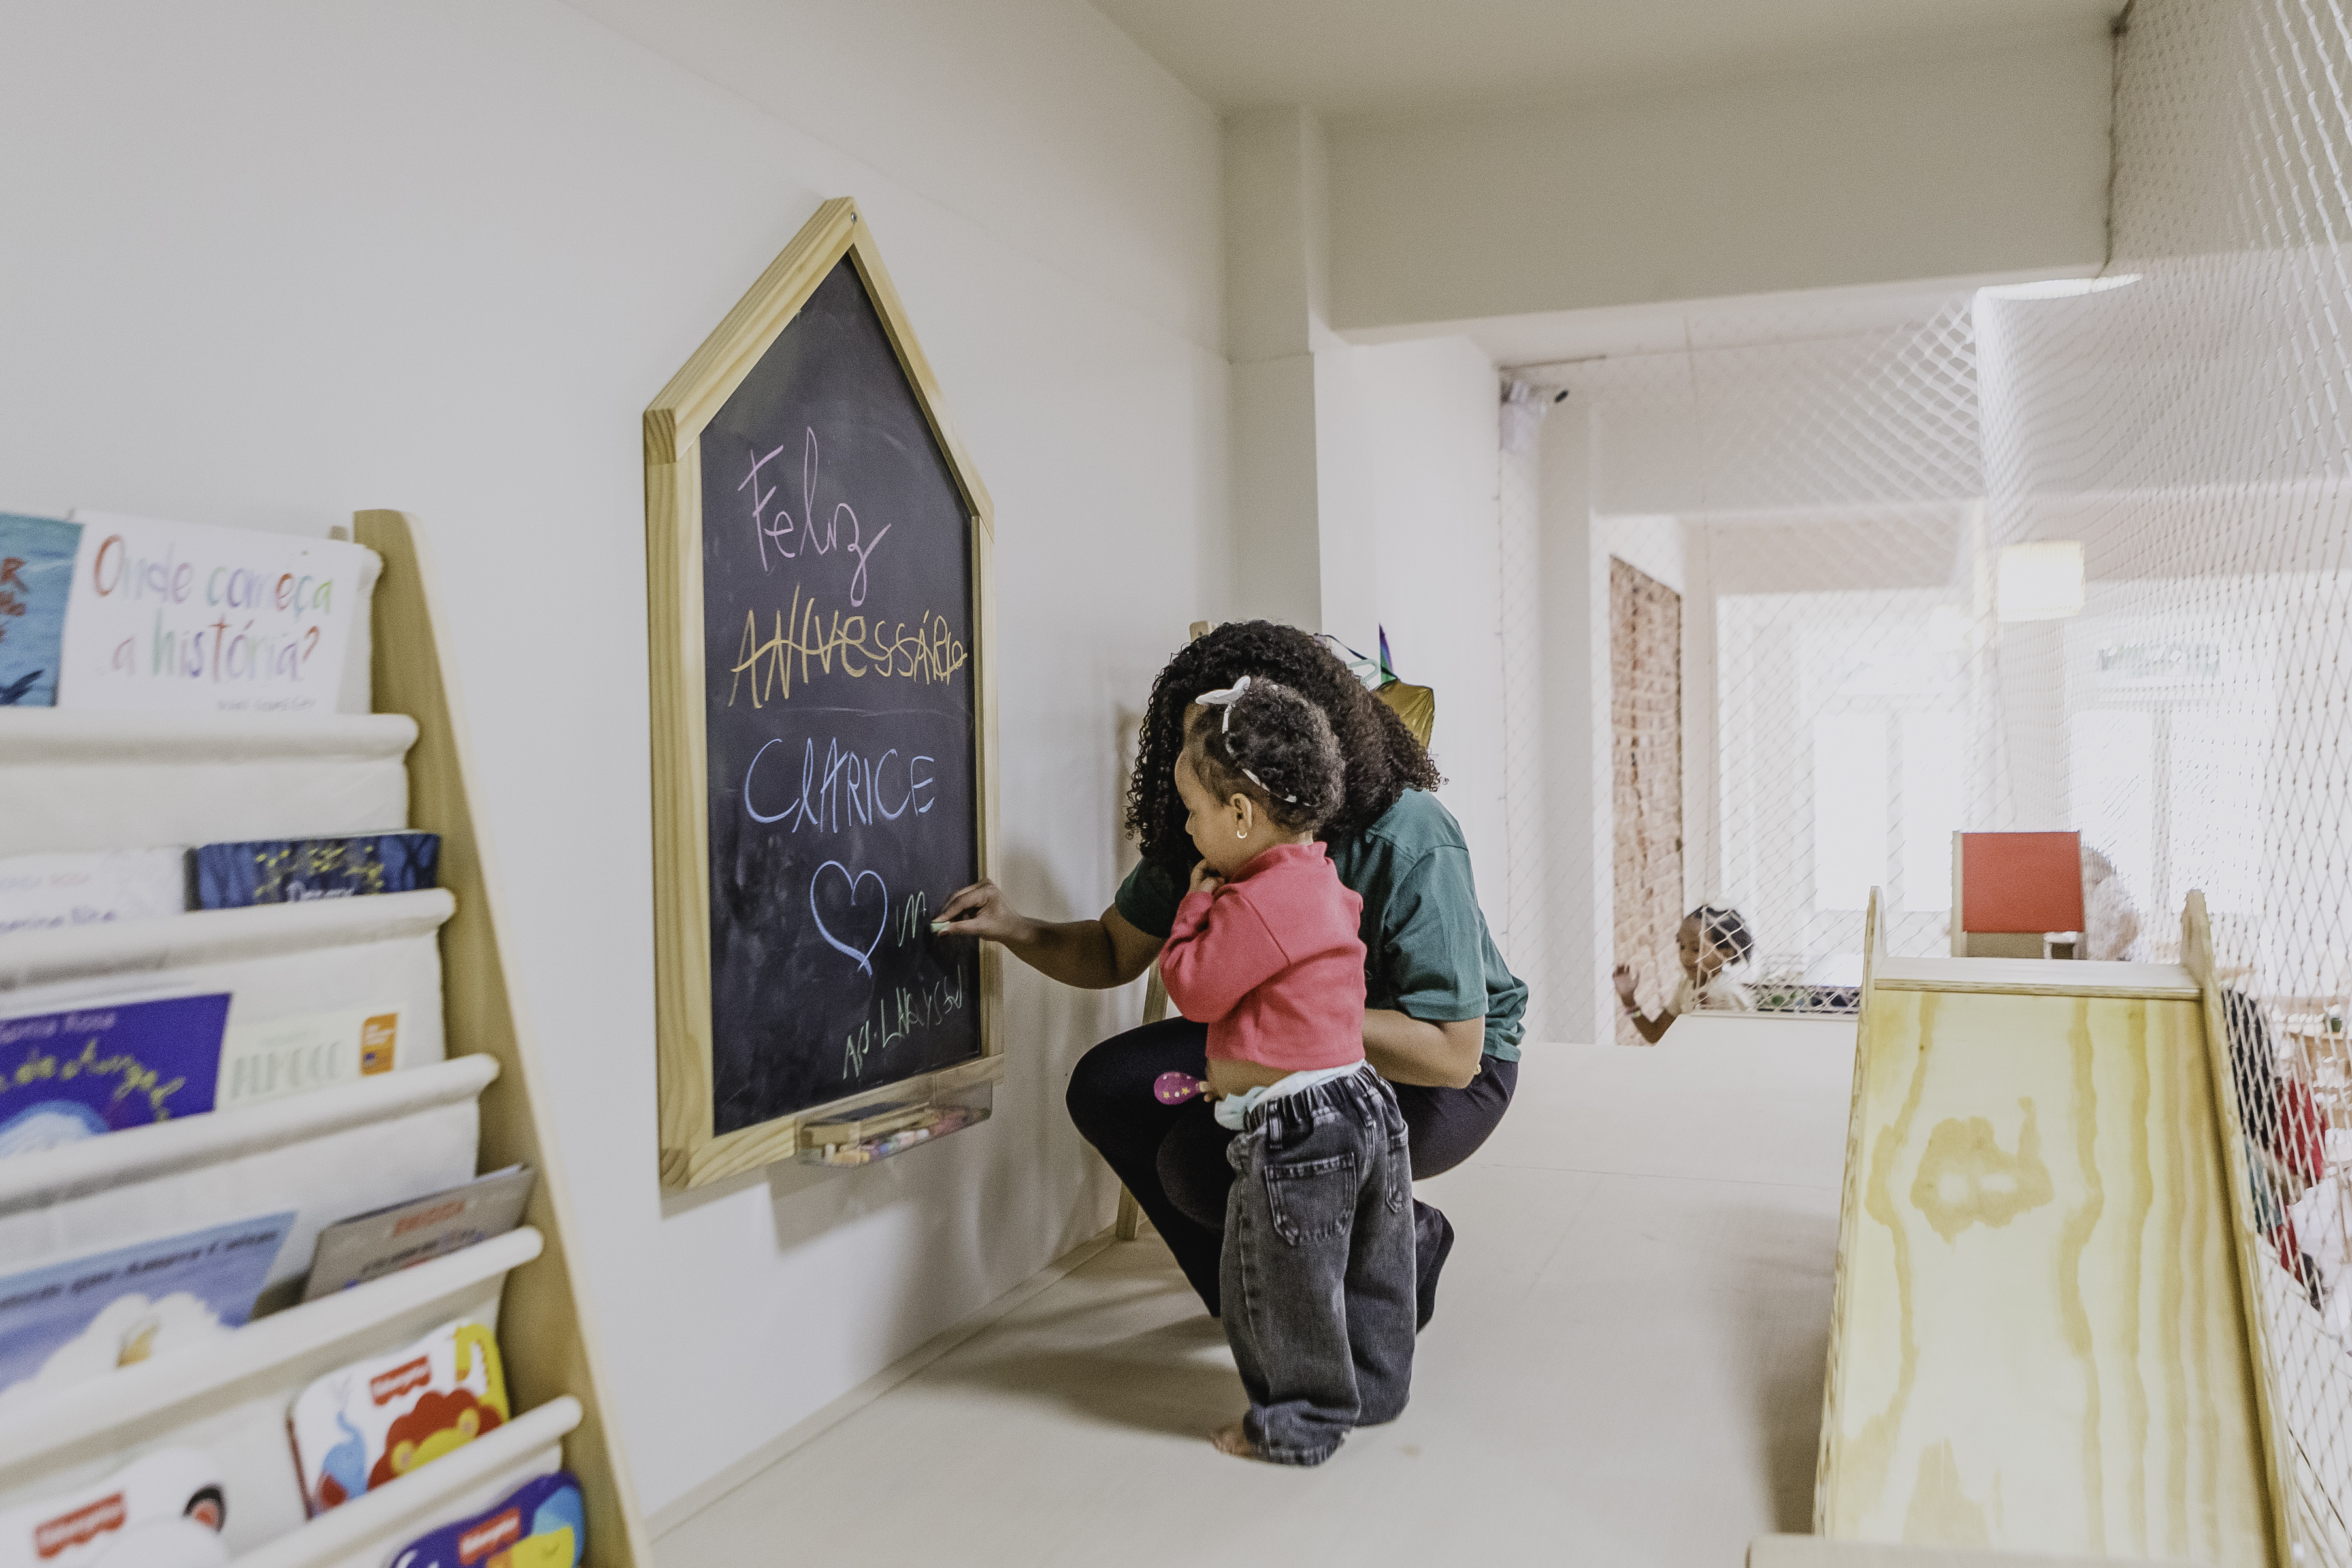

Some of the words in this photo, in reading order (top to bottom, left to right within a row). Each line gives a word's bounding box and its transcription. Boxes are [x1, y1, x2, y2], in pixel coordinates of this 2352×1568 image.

[738, 426, 892, 608] Feliz
[93, 534, 195, 604] Onde
[205, 566, 334, 623] começa
[111, 634, 137, 676] a
[152, 608, 320, 683] história?
